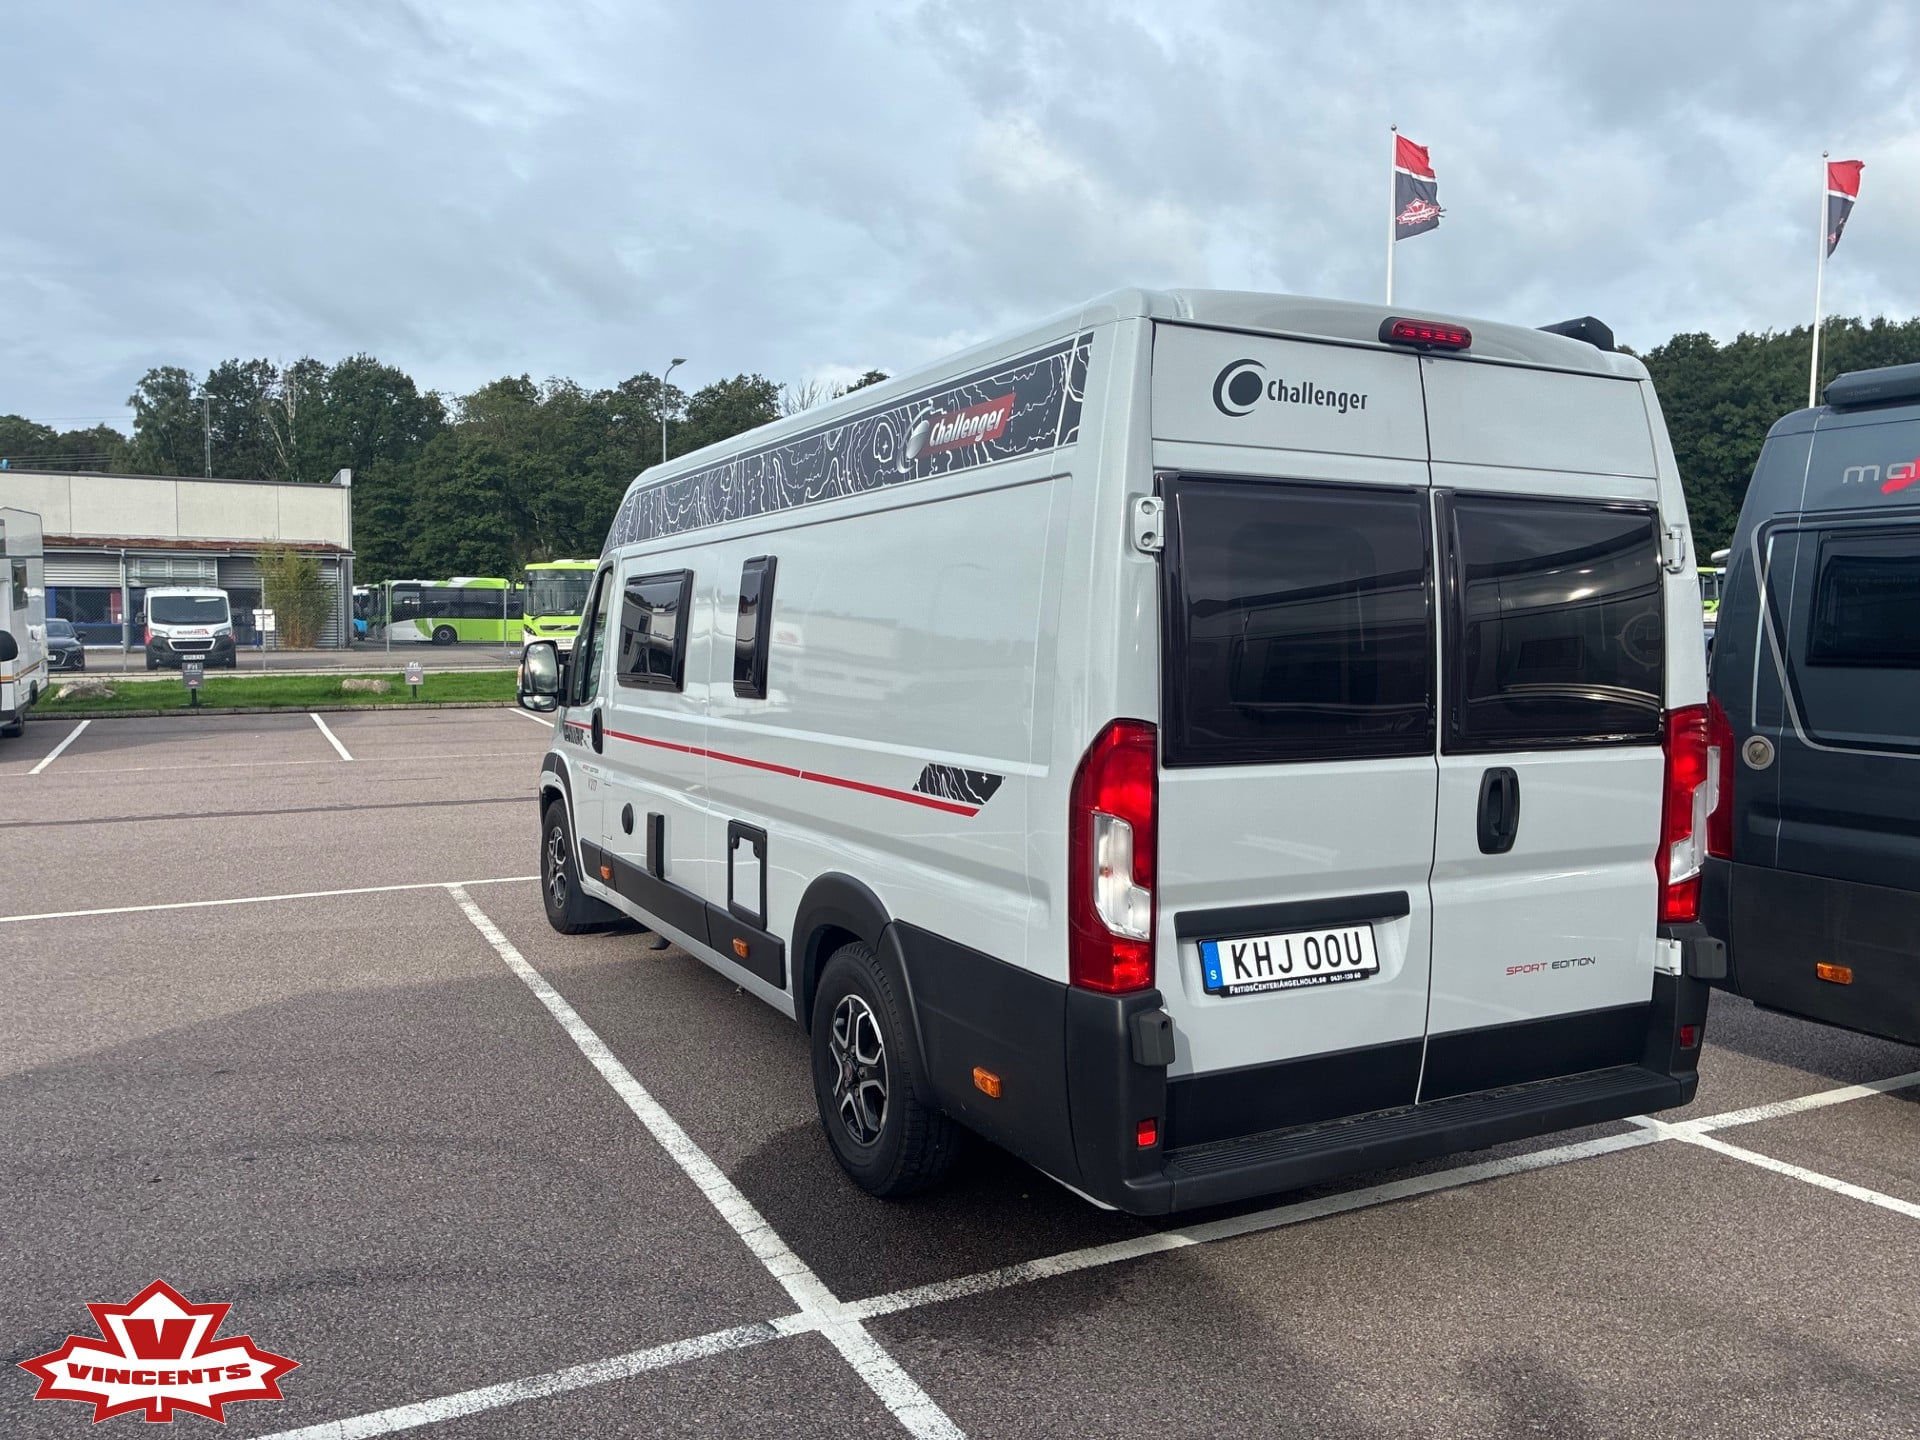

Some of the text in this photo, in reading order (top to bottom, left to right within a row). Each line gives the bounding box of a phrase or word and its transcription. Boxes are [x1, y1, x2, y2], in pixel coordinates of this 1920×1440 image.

[1267, 379, 1368, 414] Challenger
[929, 408, 1005, 447] Challenger
[1210, 970, 1218, 980] S
[1231, 939, 1294, 980] KHJ
[1506, 956, 1596, 976] SPORT EDITION
